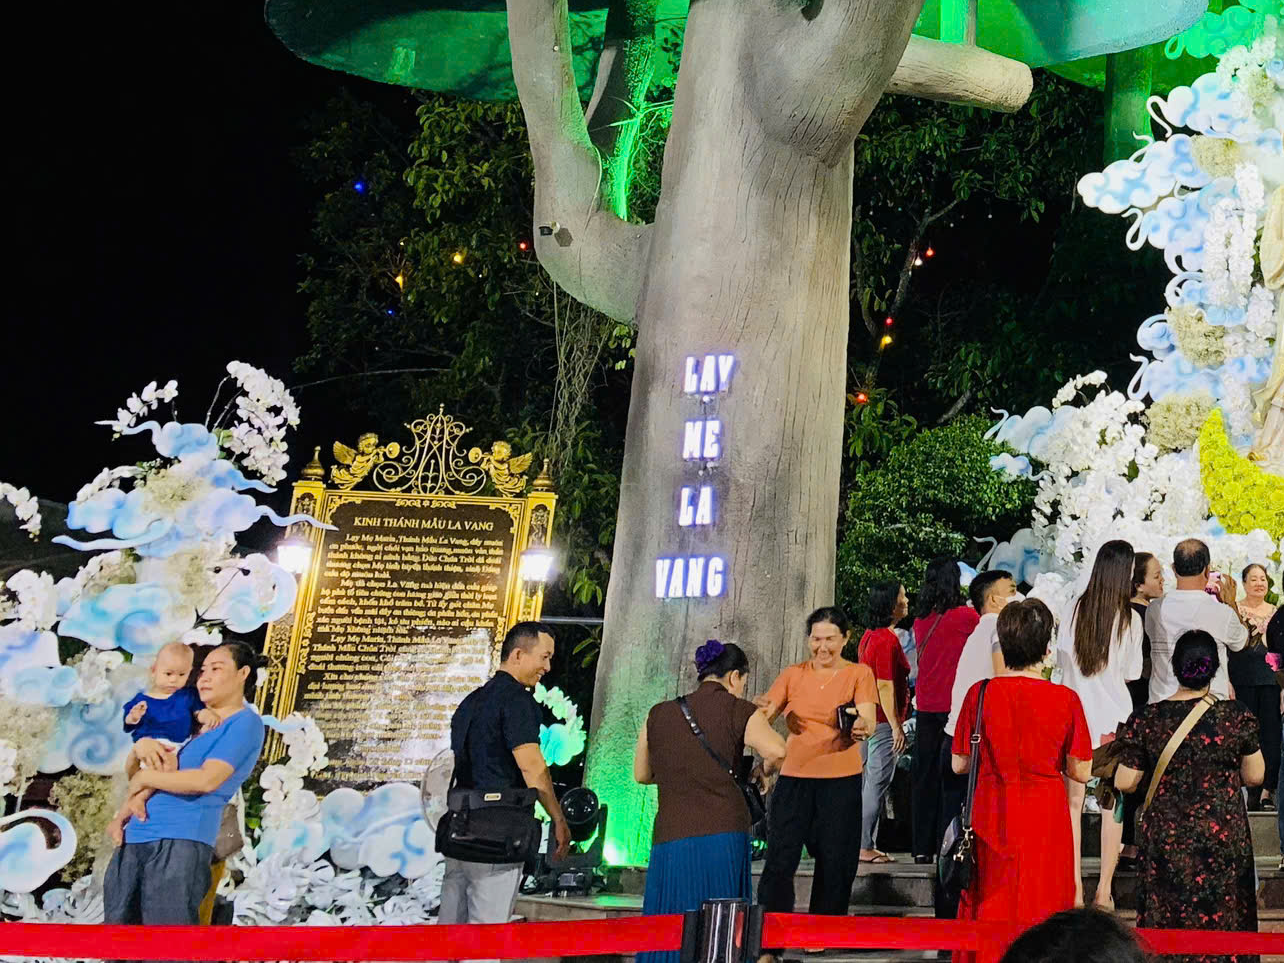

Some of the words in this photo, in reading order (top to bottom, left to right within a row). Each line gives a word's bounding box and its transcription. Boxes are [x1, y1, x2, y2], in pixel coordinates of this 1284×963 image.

[353, 516, 381, 526] KINH
[382, 516, 420, 528] THÁNH
[447, 519, 462, 530] LA
[463, 520, 494, 531] VANG
[678, 486, 713, 526] LA
[655, 556, 725, 599] VANG
